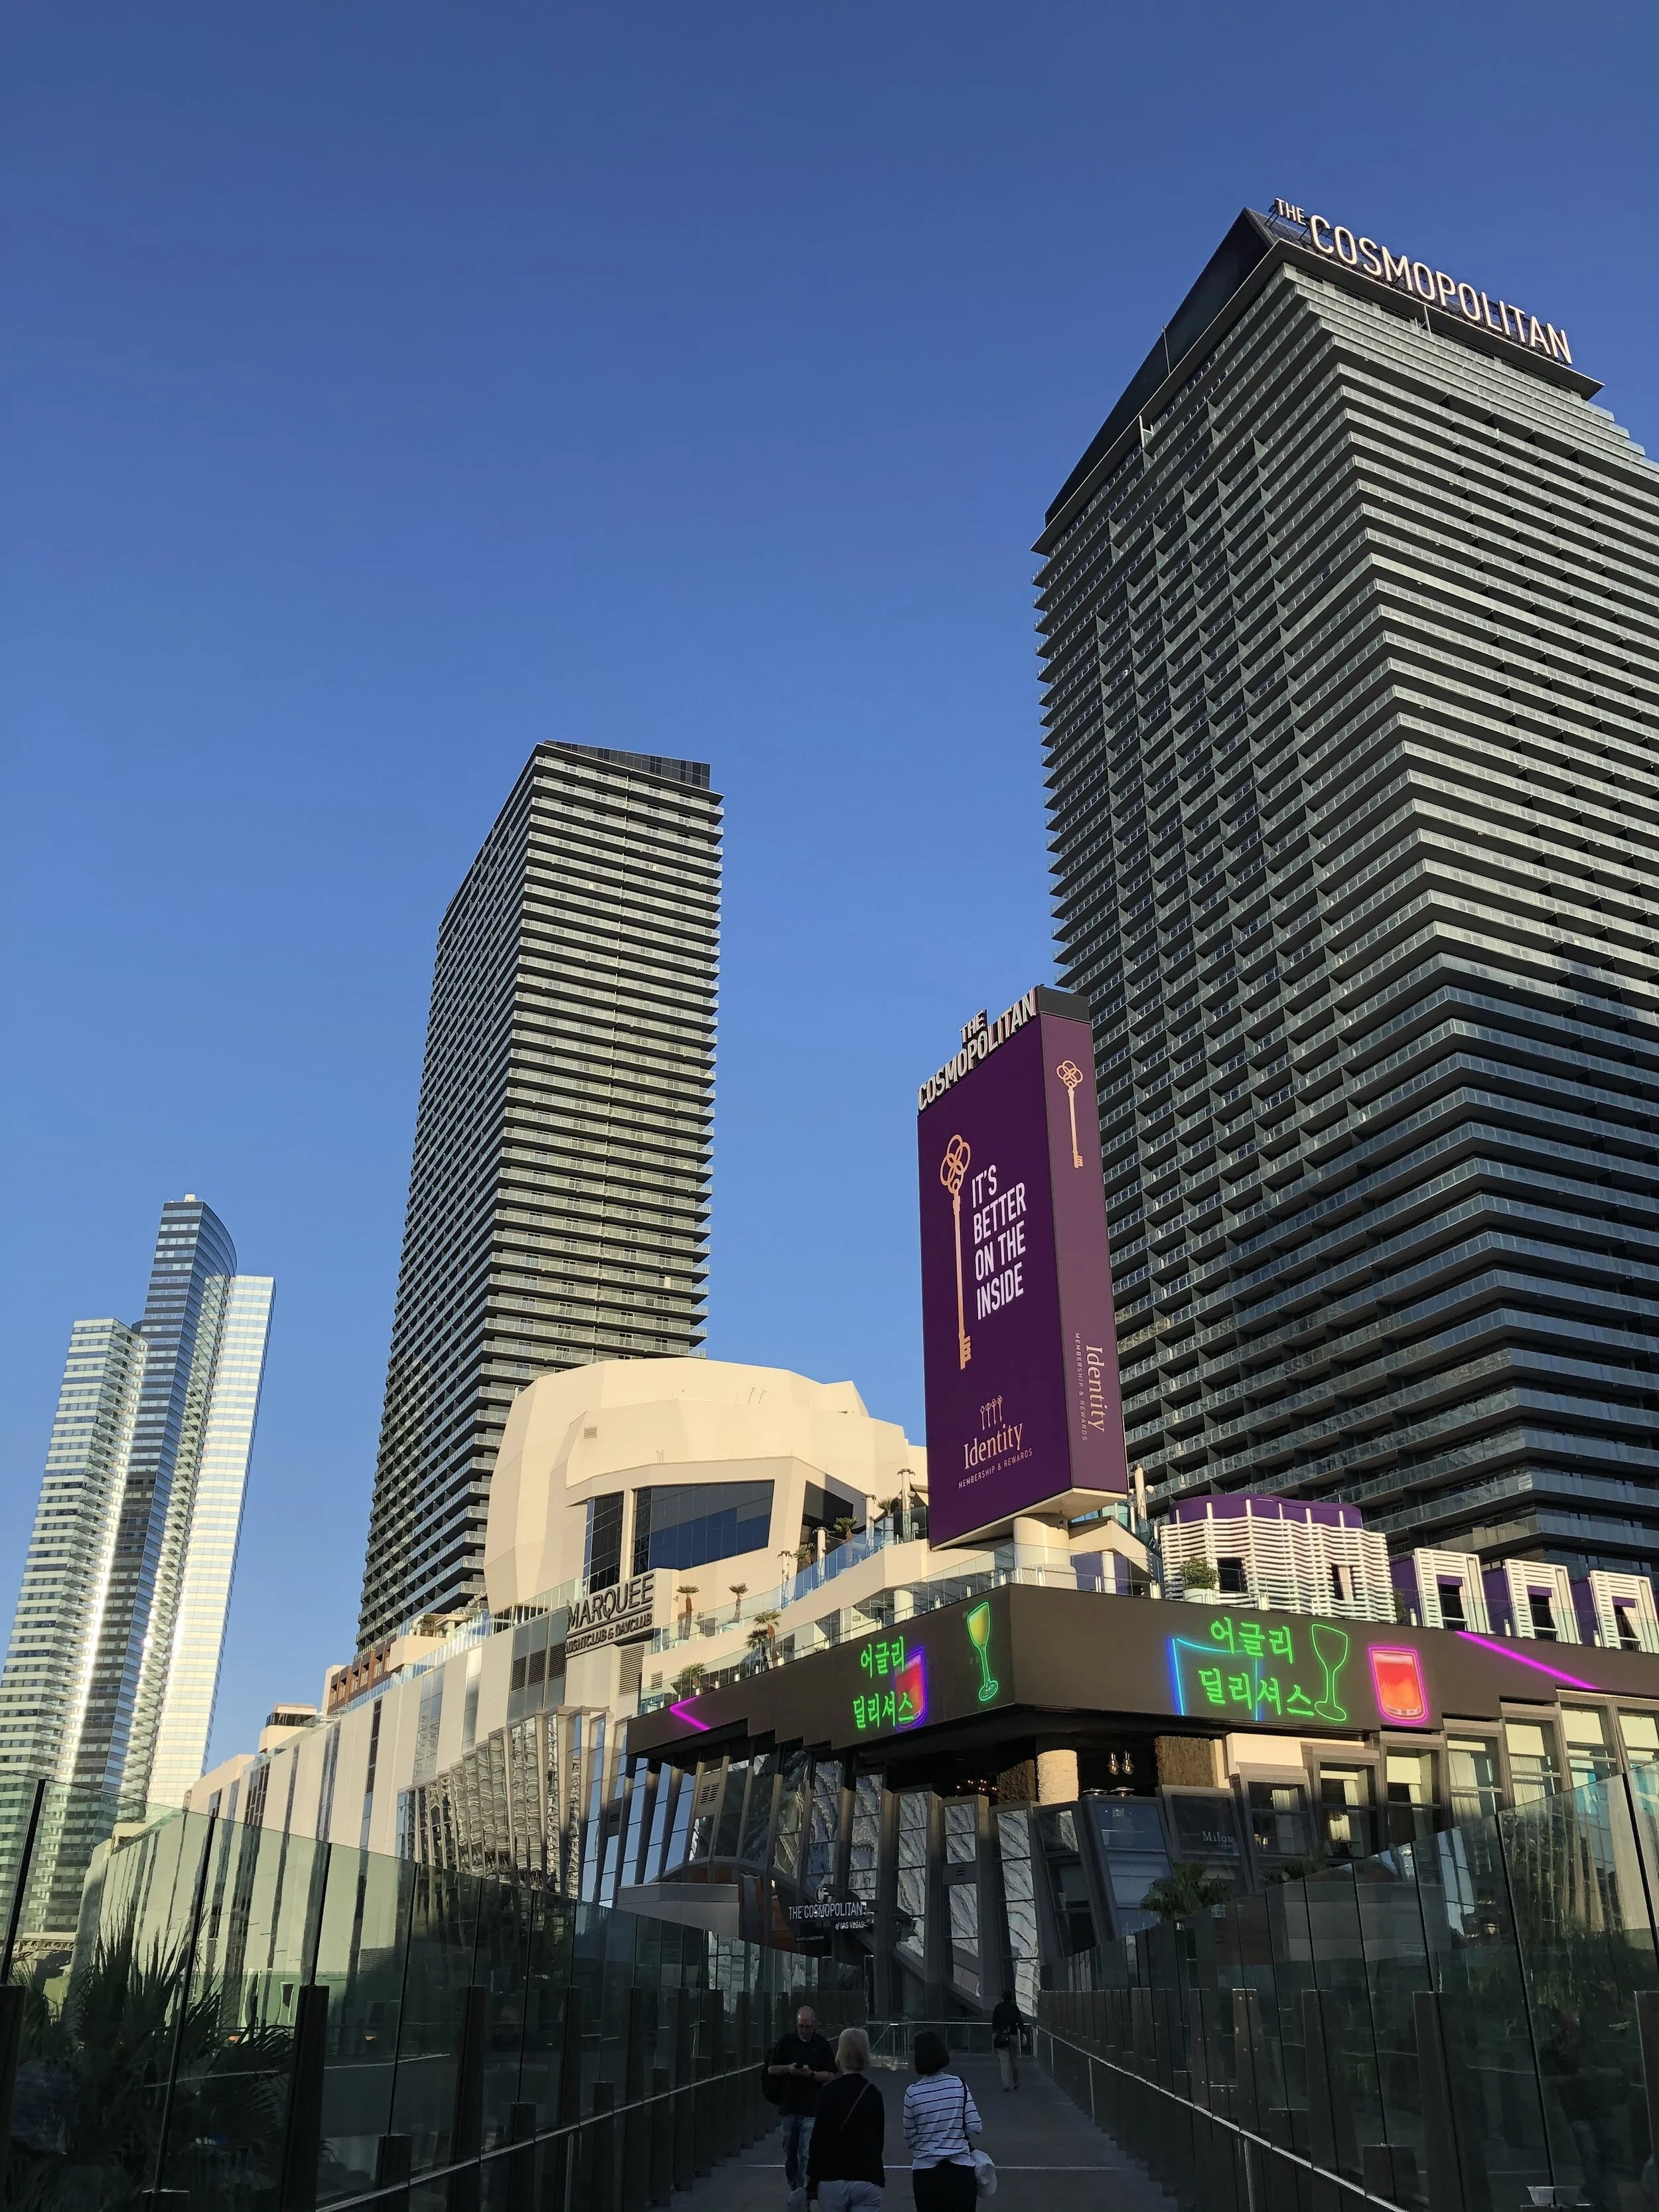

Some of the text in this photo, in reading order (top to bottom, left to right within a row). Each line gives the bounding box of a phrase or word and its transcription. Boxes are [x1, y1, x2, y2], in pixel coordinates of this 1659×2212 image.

[1275, 197, 1573, 364] THE COSMOPOLITAN
[917, 986, 1037, 1111] COSMOPOLITAN
[960, 1009, 986, 1043] THE
[972, 1164, 997, 1209] IT'S
[974, 1182, 1027, 1245] BETTER
[975, 1220, 1026, 1282] ON THE
[977, 1262, 1025, 1321] INSIDE
[1074, 1332, 1084, 1387] MEMBERSHIP
[1079, 1400, 1088, 1440] REWARDS
[1086, 1345, 1108, 1432] Identity
[958, 1465, 995, 1489] MEMBERSHIP
[1003, 1447, 1033, 1467] REWARDS
[964, 1422, 1023, 1469] Identity
[566, 1573, 654, 1632] MARQUEE
[565, 1612, 653, 1653] NIGHTCLUB & DAYCLUB
[1209, 1617, 1293, 1664] 어글리
[860, 1635, 905, 1678] 어글리
[853, 1690, 914, 1729] 딜리셔스
[1198, 1668, 1315, 1717] 딜리셔스
[1202, 1830, 1232, 1842] Milos
[788, 1901, 863, 1919] THE COSMOPOLITAN
